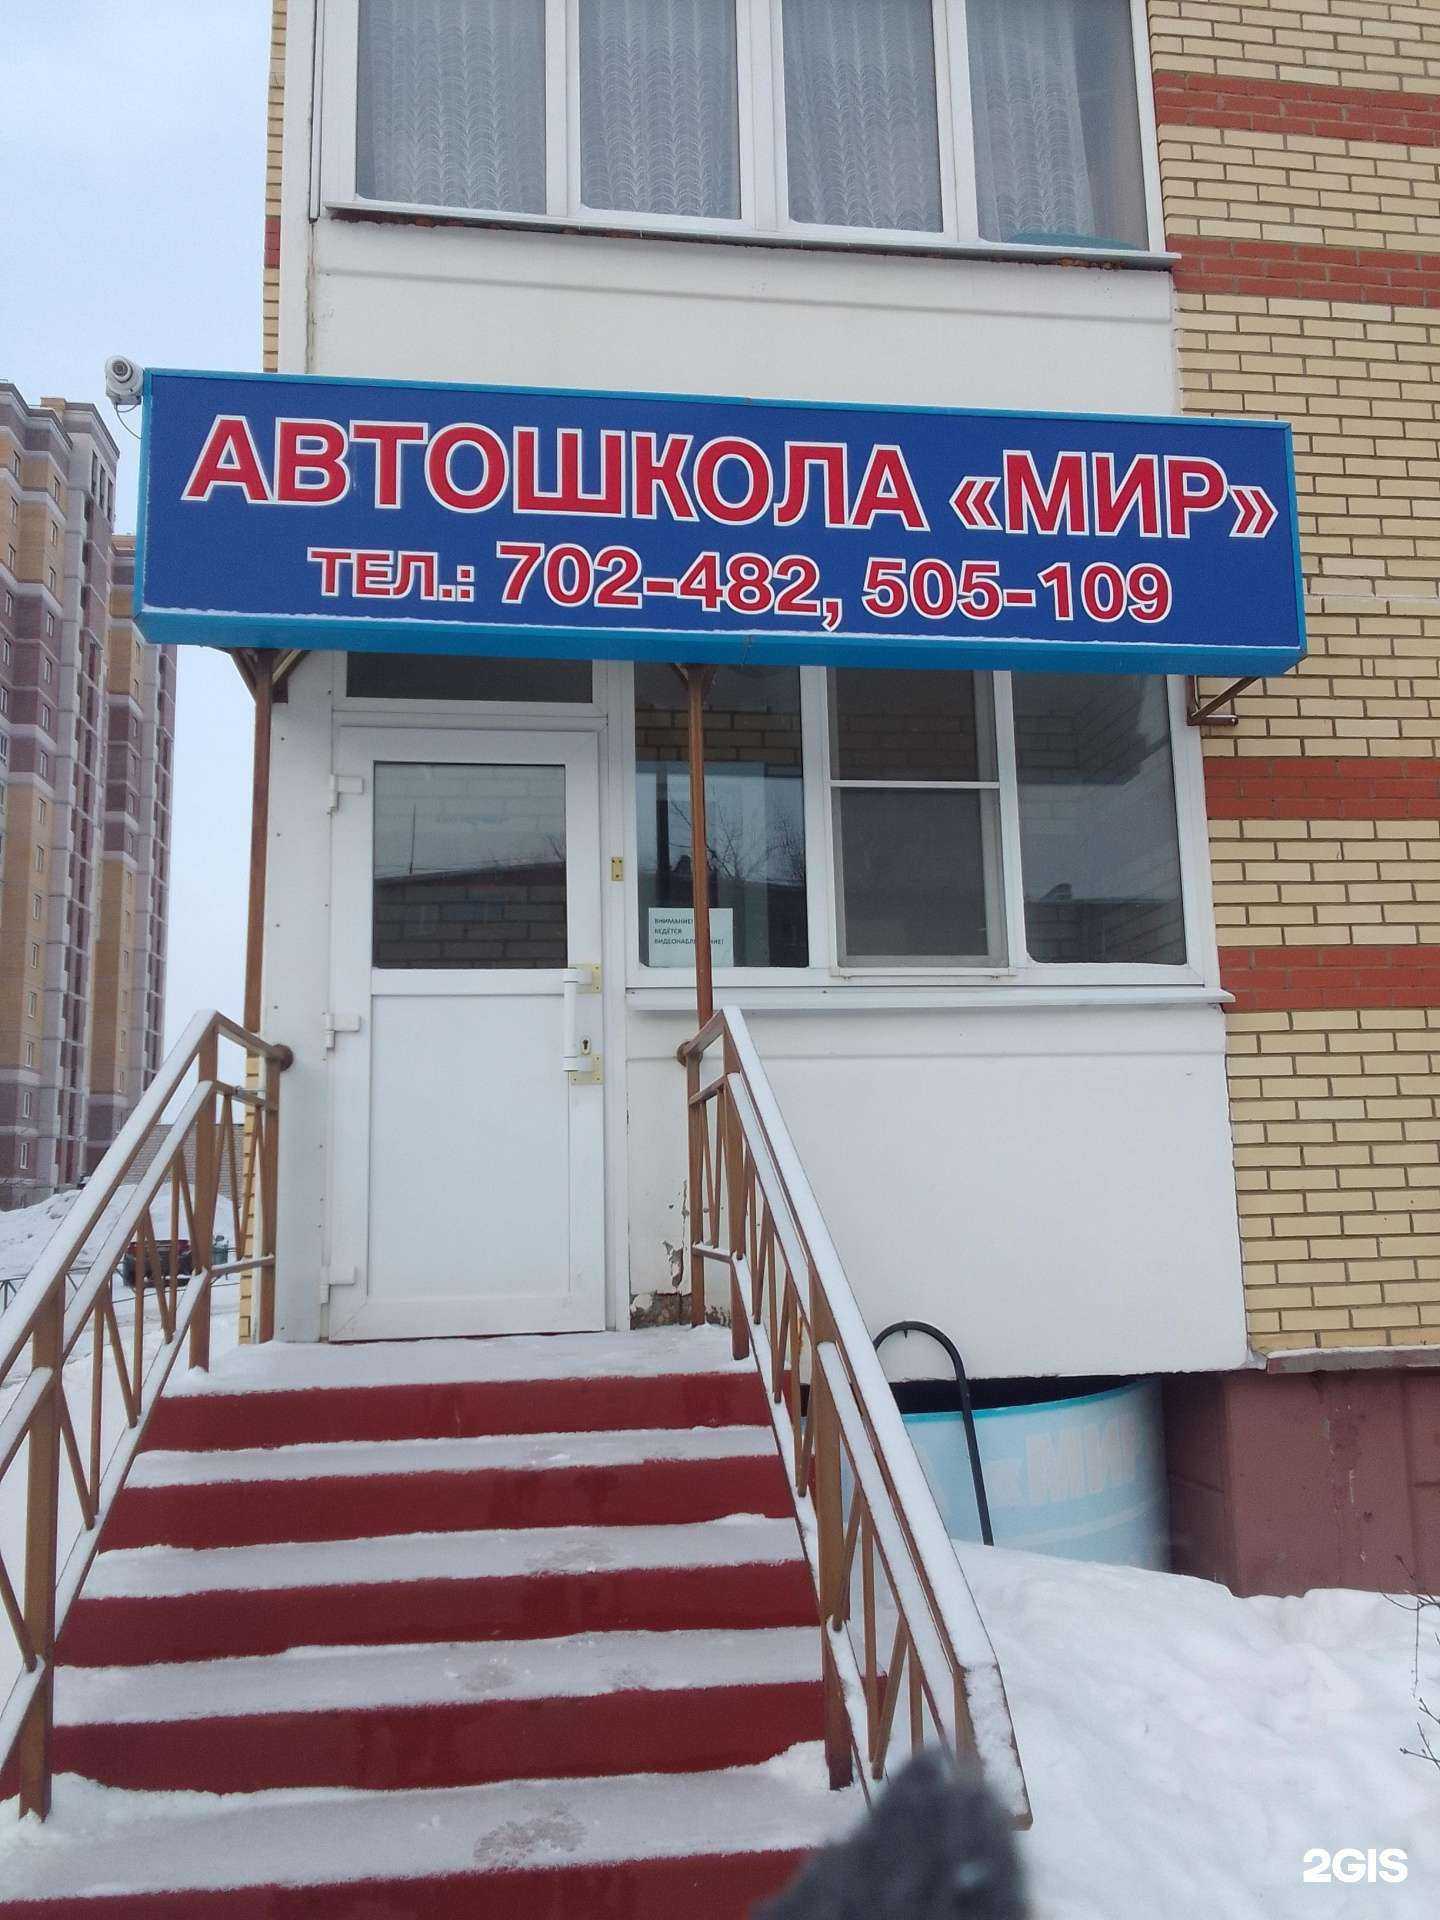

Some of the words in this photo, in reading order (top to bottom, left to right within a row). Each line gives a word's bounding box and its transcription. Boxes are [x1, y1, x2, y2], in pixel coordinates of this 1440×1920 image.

[181, 414, 930, 532] АВТОШКОЛА
[949, 449, 1278, 539] «МИР»
[307, 547, 474, 602] ТЕЛ.:
[496, 541, 842, 631] 702-482,
[861, 556, 1172, 623] 505-109
